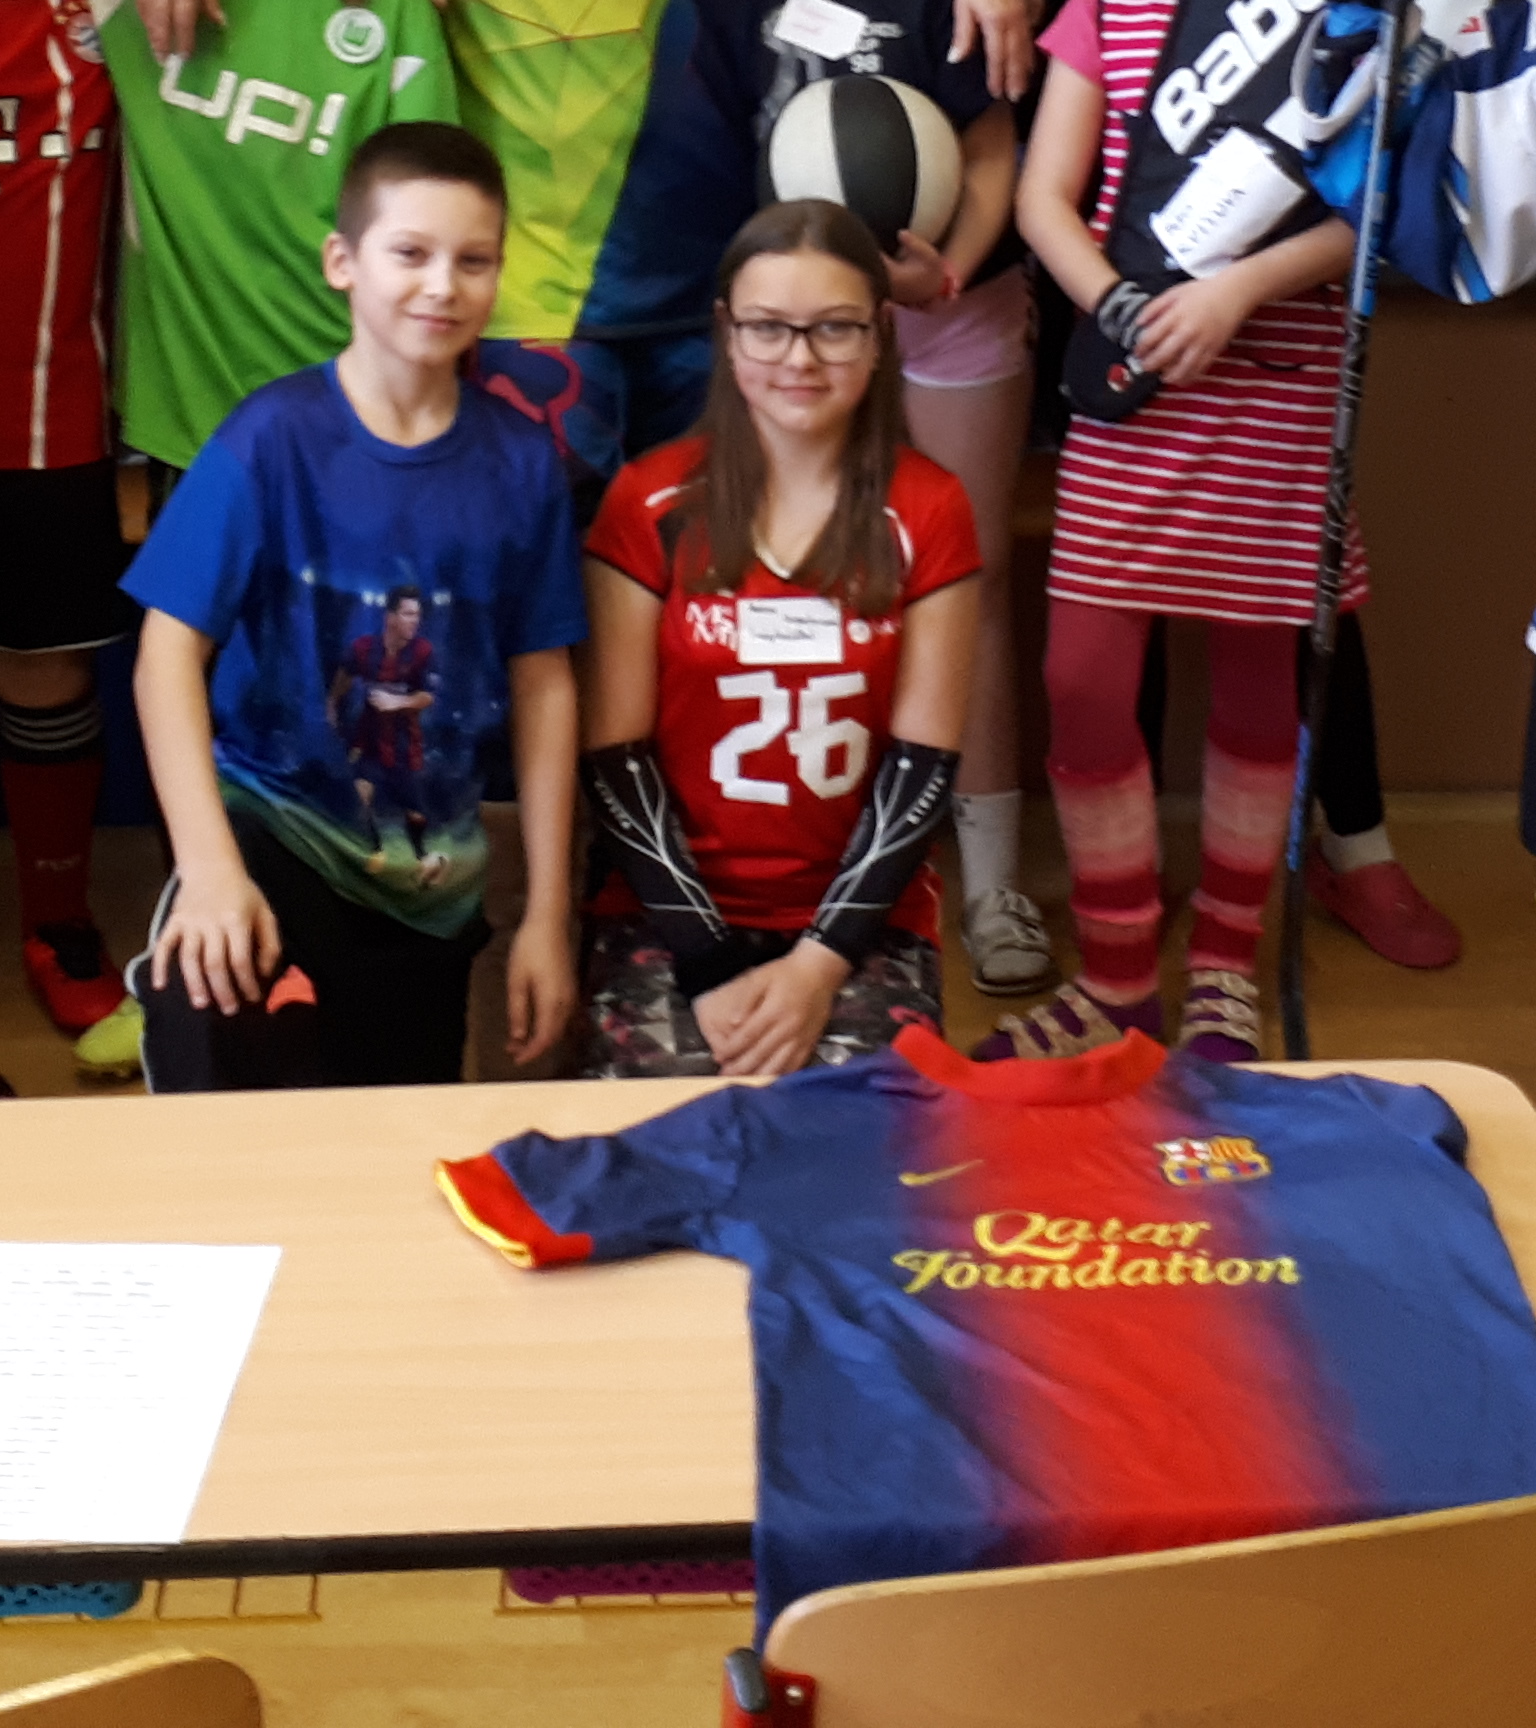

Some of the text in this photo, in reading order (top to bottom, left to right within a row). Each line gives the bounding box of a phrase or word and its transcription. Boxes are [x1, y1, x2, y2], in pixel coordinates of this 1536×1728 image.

[710, 671, 868, 806] 26
[973, 1208, 1213, 1261] Qatar
[891, 1244, 1302, 1294] Foundation
